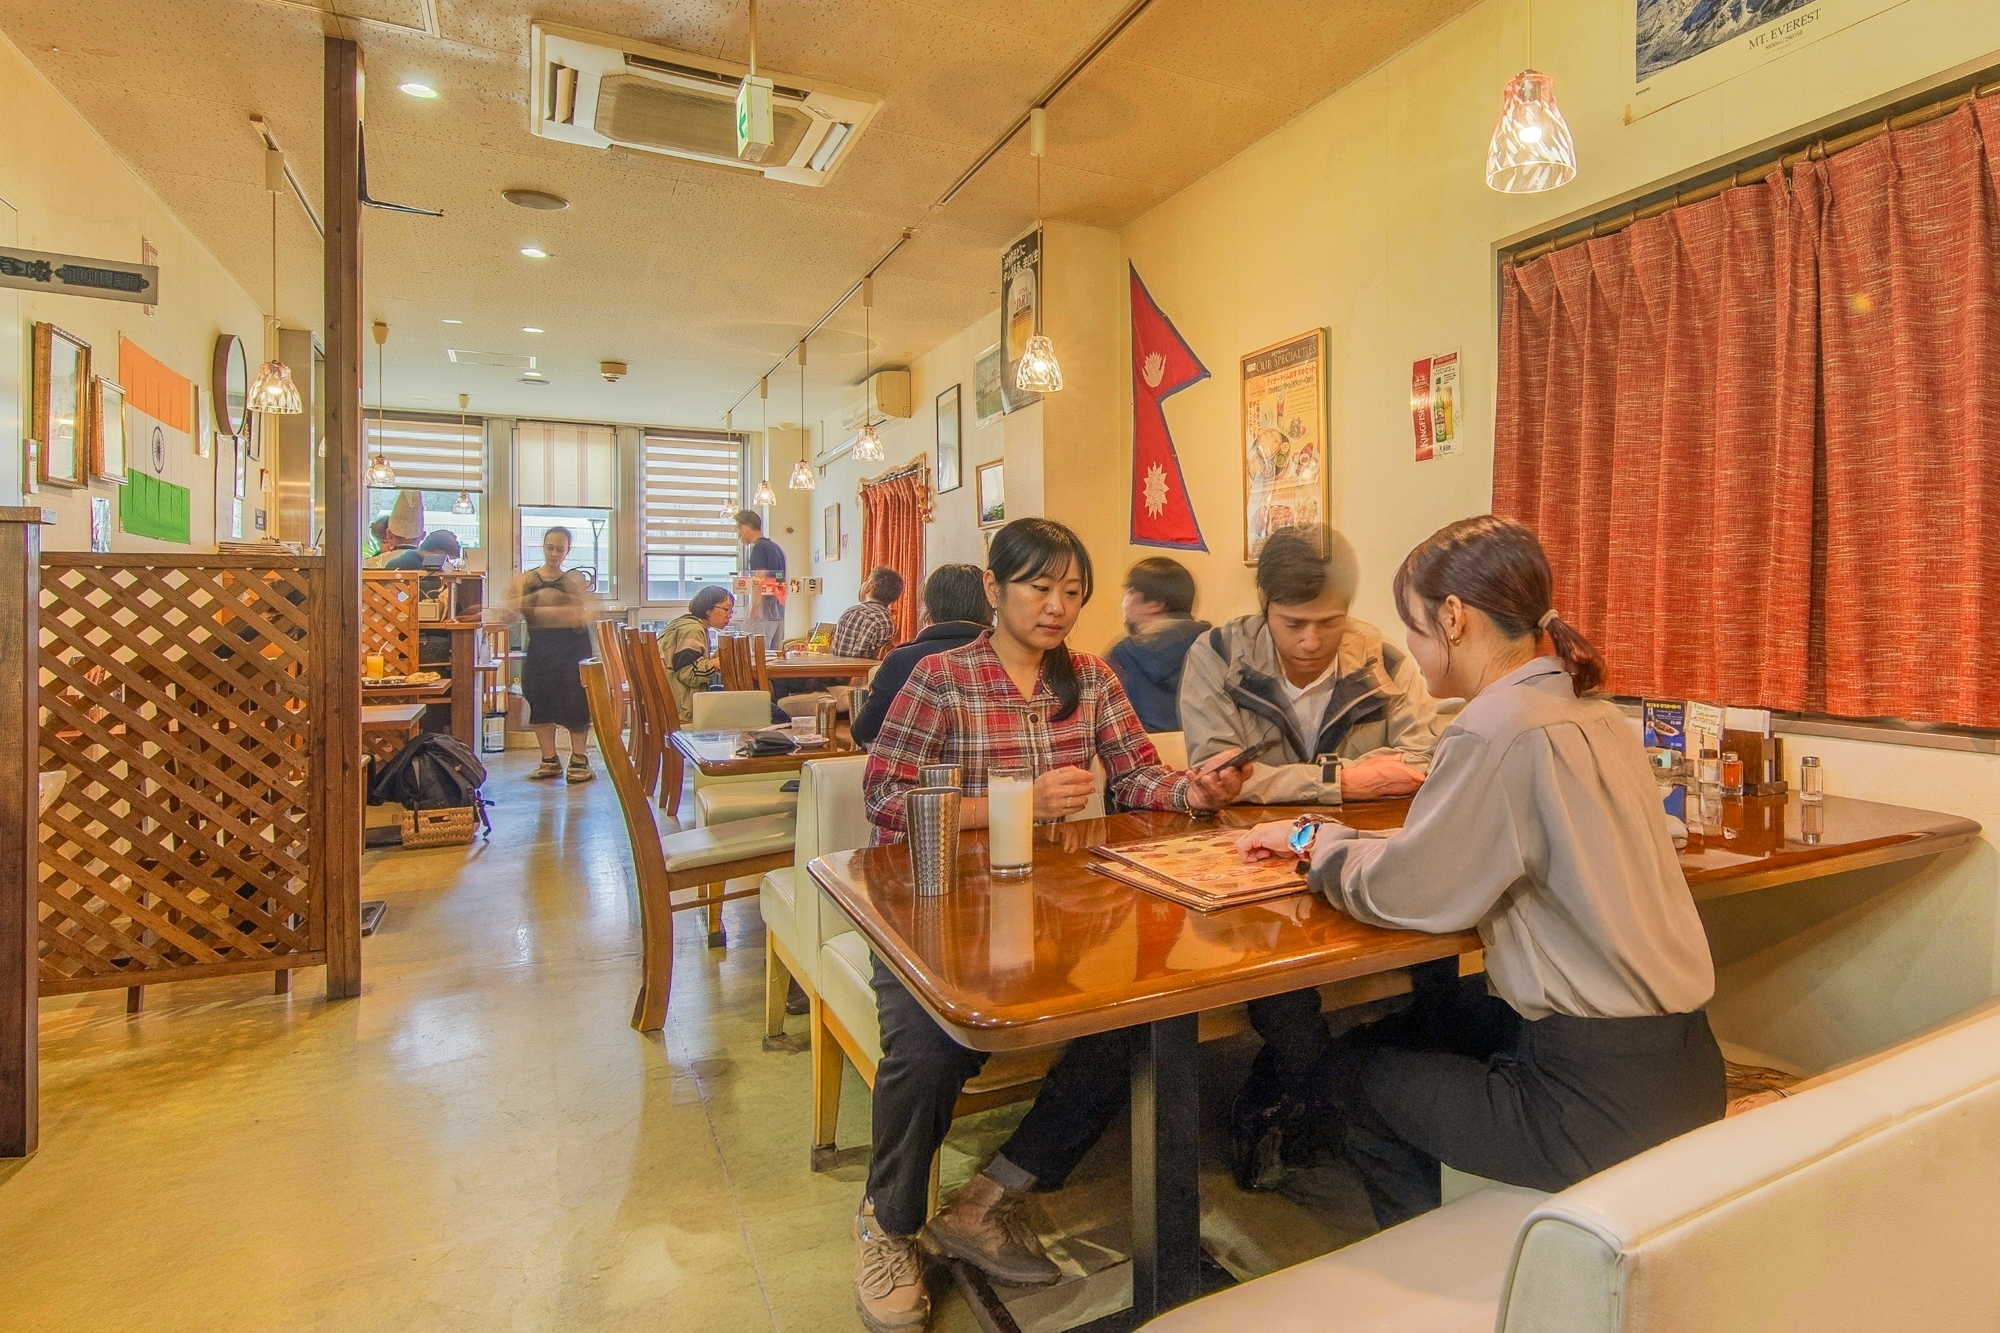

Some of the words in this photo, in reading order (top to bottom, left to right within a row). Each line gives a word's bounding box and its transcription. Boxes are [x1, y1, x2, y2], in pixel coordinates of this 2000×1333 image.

[1749, 33, 1769, 50] MT.
[1771, 8, 1822, 40] EVEREST
[69, 267, 137, 289] TOILET
[1256, 359, 1273, 373] OUR
[1274, 344, 1317, 367] SPECIALTIES
